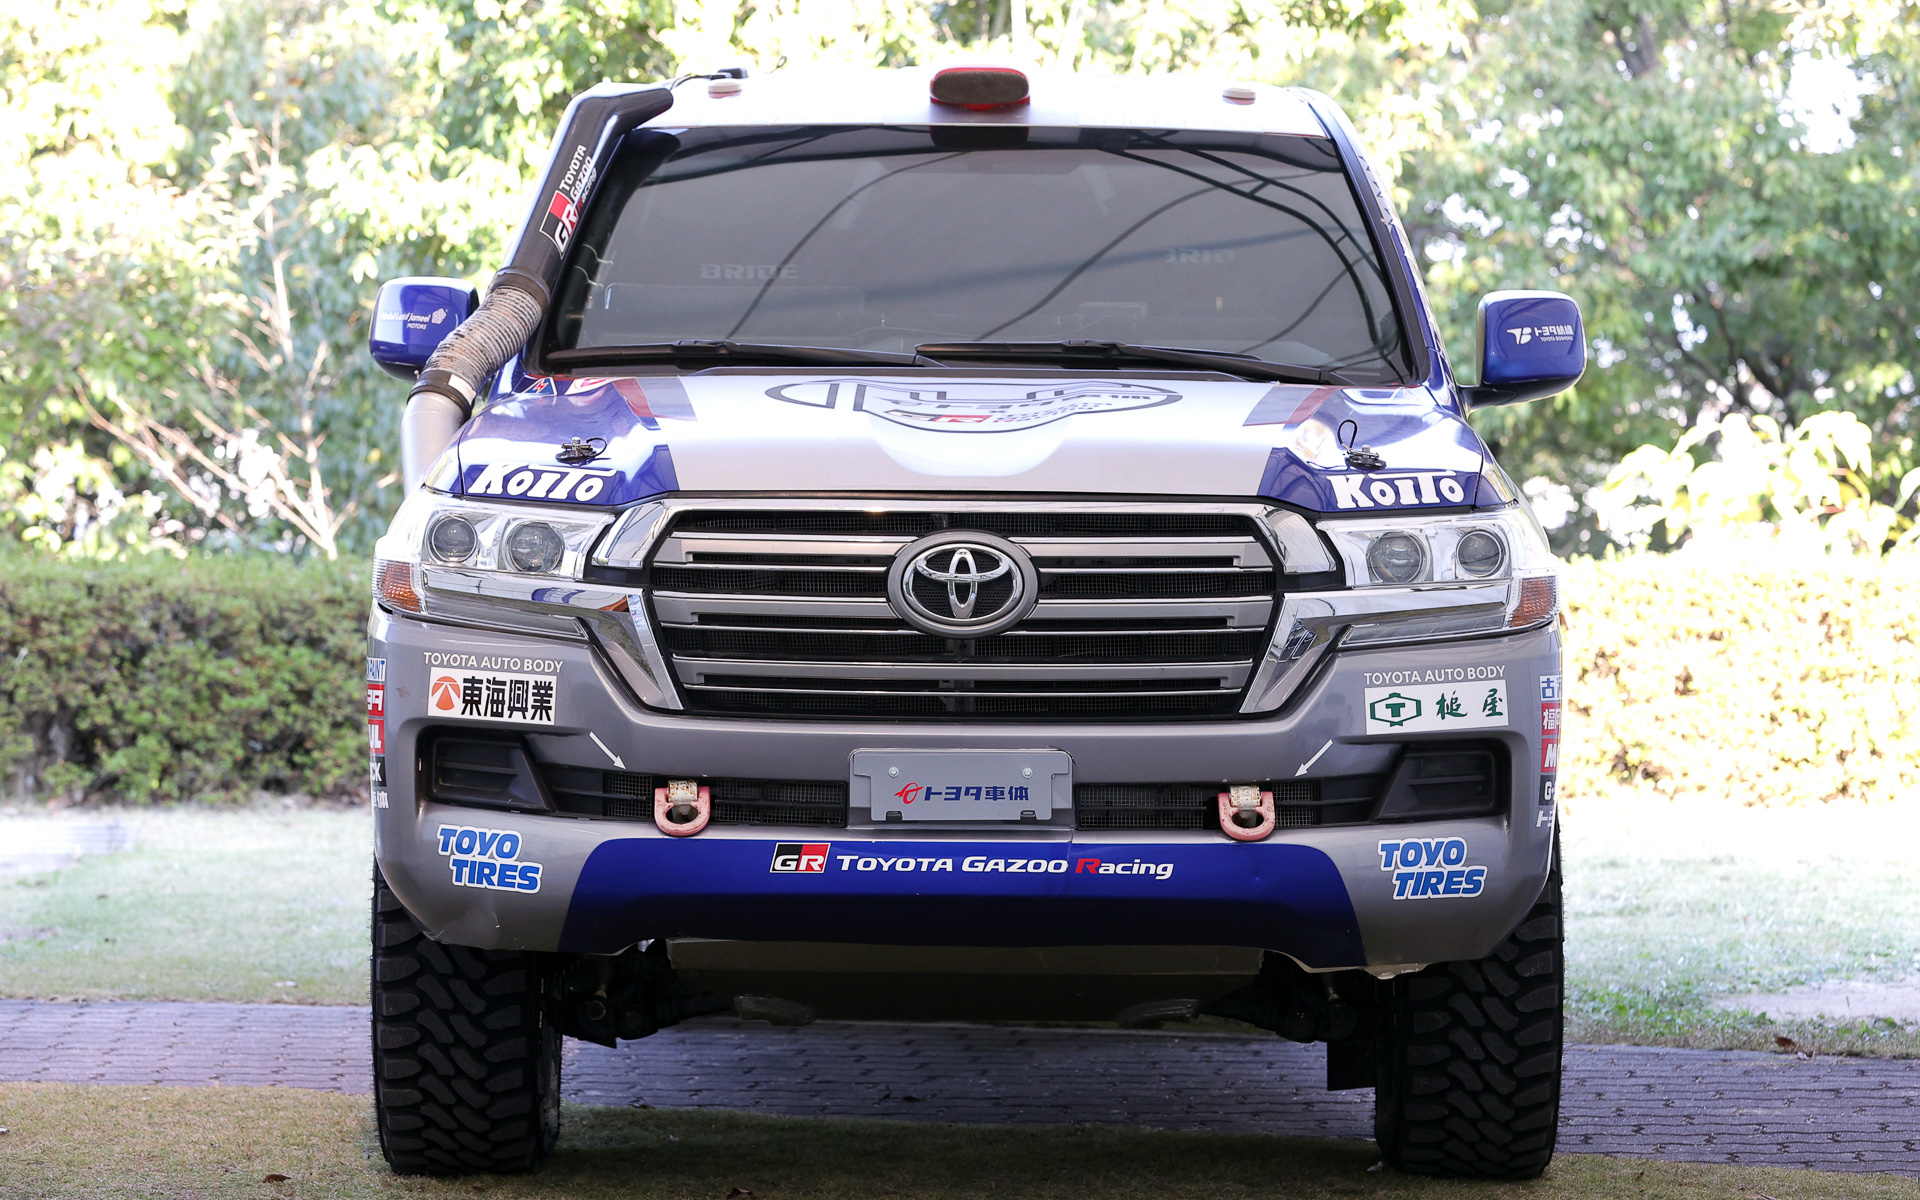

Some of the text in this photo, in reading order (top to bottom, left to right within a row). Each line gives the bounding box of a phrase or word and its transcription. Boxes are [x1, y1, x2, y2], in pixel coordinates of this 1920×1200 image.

[559, 144, 587, 191] TOYOTA
[554, 203, 579, 253] GR
[701, 263, 798, 280] BRIDE
[423, 651, 564, 673] TOYOTA AUTO BODY
[1364, 665, 1506, 685] TOYOTA AUTO BODY
[461, 676, 554, 722] 東海興業
[924, 784, 1030, 802] トヨタ車体
[438, 827, 521, 860] TOYO
[1380, 839, 1466, 869] TOYO
[451, 858, 541, 892] TIRES
[772, 851, 1174, 880] GR TOYOTA GAZOO Racing
[1395, 868, 1485, 897] TIRES
